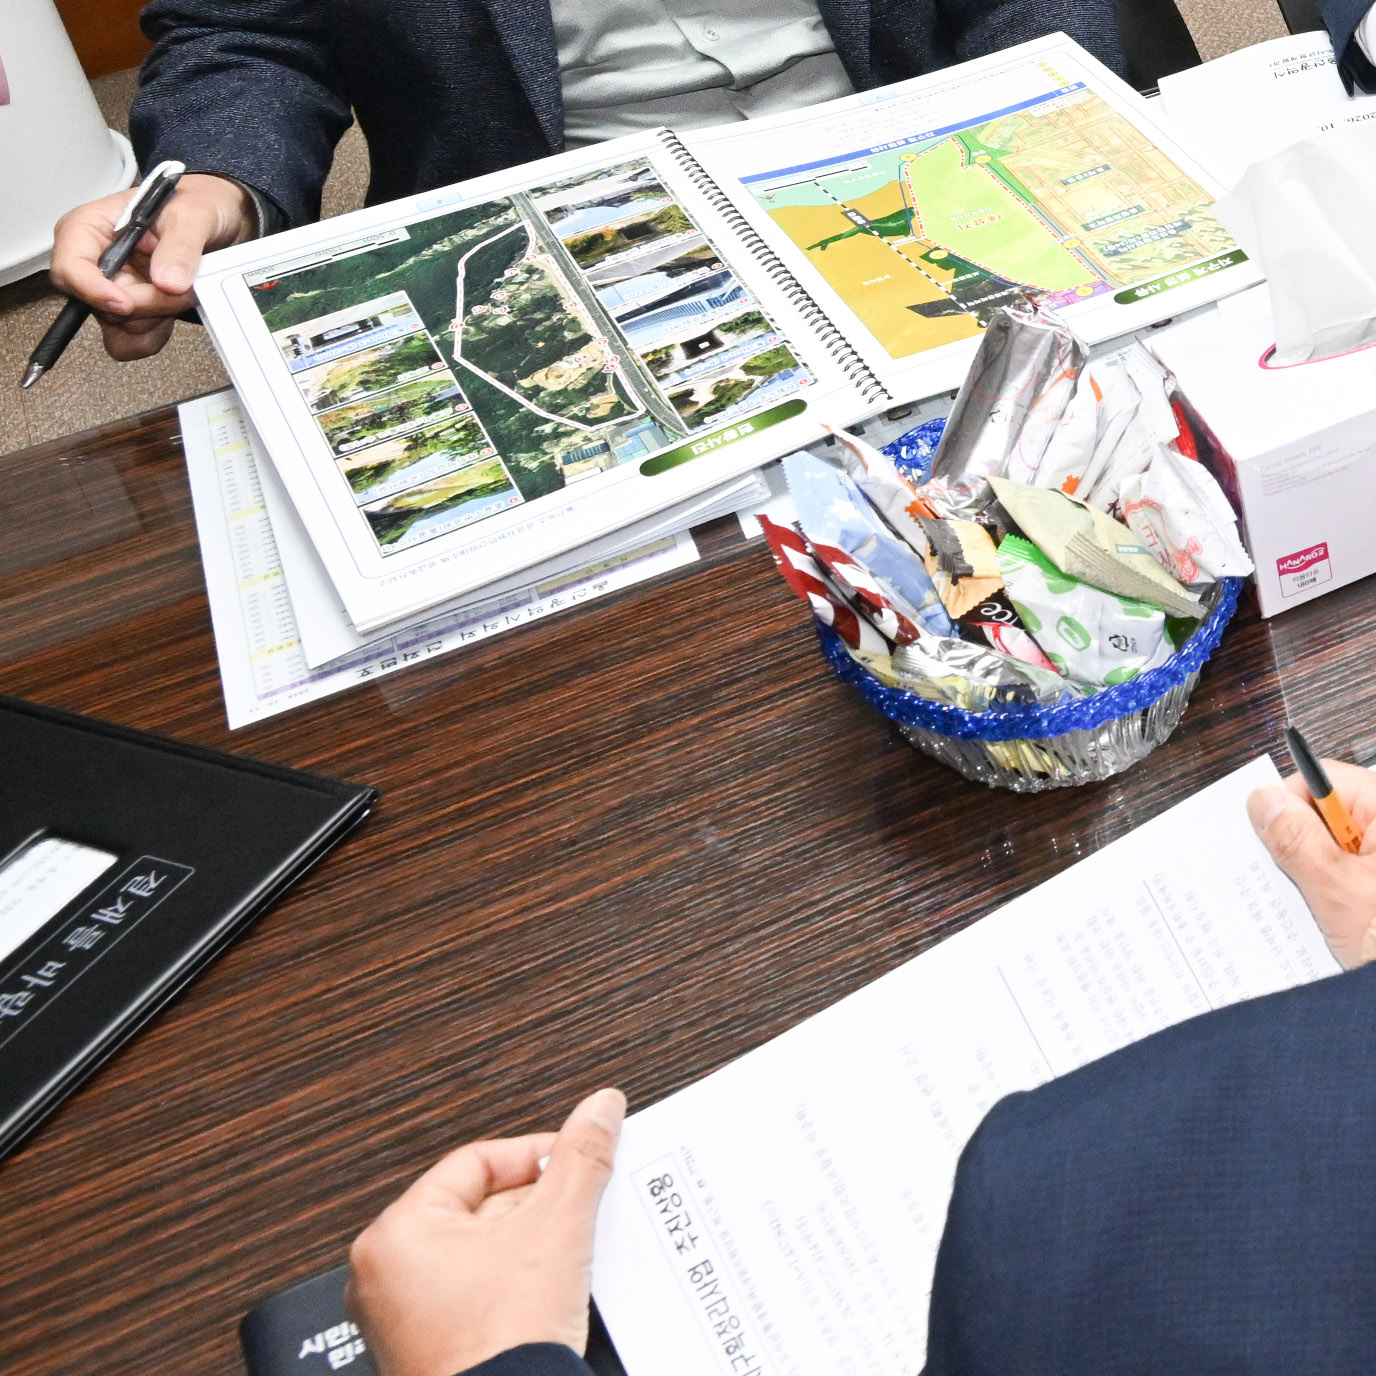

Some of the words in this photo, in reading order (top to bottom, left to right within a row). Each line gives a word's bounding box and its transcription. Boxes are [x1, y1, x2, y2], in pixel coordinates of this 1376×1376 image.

[957, 213, 1002, 231] 대상지
[1164, 271, 1191, 288] 설정
[1192, 257, 1234, 277] 지구계
[1135, 282, 1162, 298] 사유
[690, 423, 754, 455] 현황사진
[357, 640, 446, 678] 전화번호
[64, 868, 168, 951] 결재를
[646, 1173, 700, 1256] 추진상황
